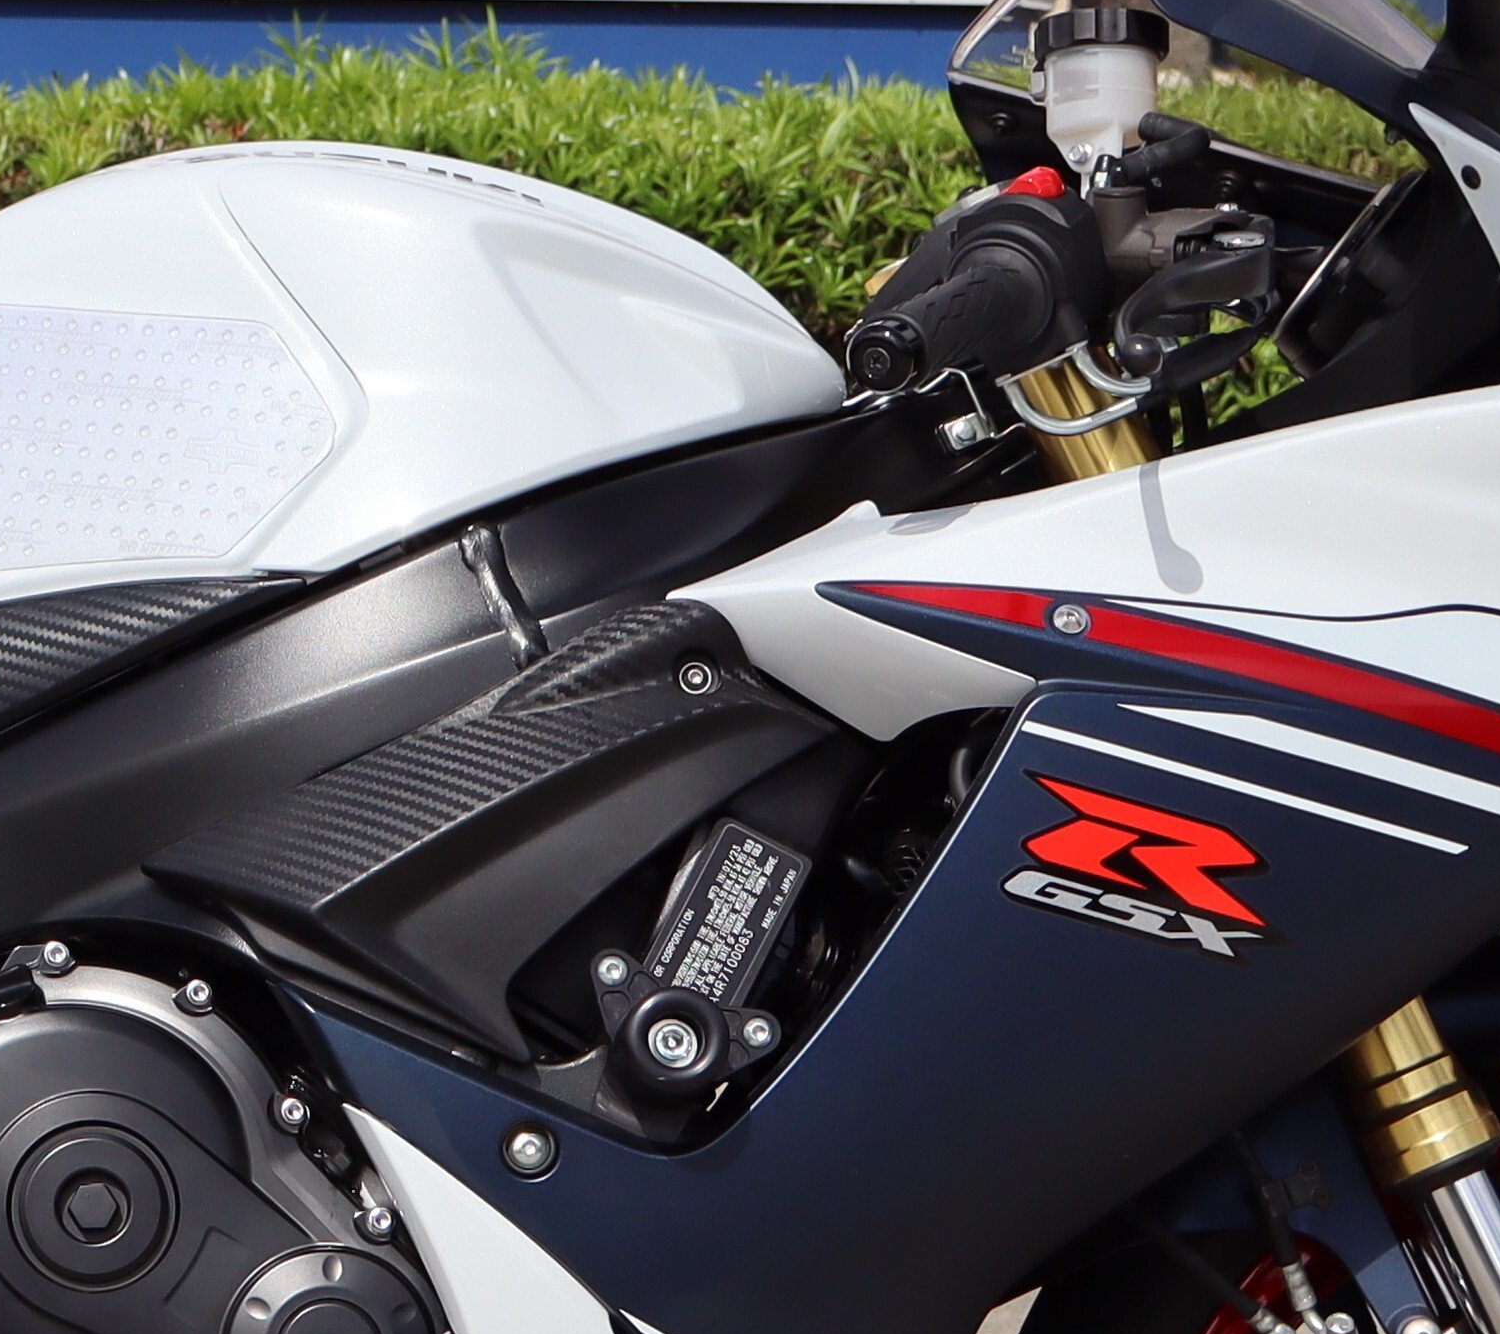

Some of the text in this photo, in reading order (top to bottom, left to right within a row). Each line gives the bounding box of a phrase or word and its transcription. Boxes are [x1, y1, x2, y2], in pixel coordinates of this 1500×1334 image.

[760, 907, 777, 929] MADE
[781, 868, 797, 895] JAPAN
[1003, 870, 1265, 957] GSX
[660, 908, 695, 964] CORPORATION
